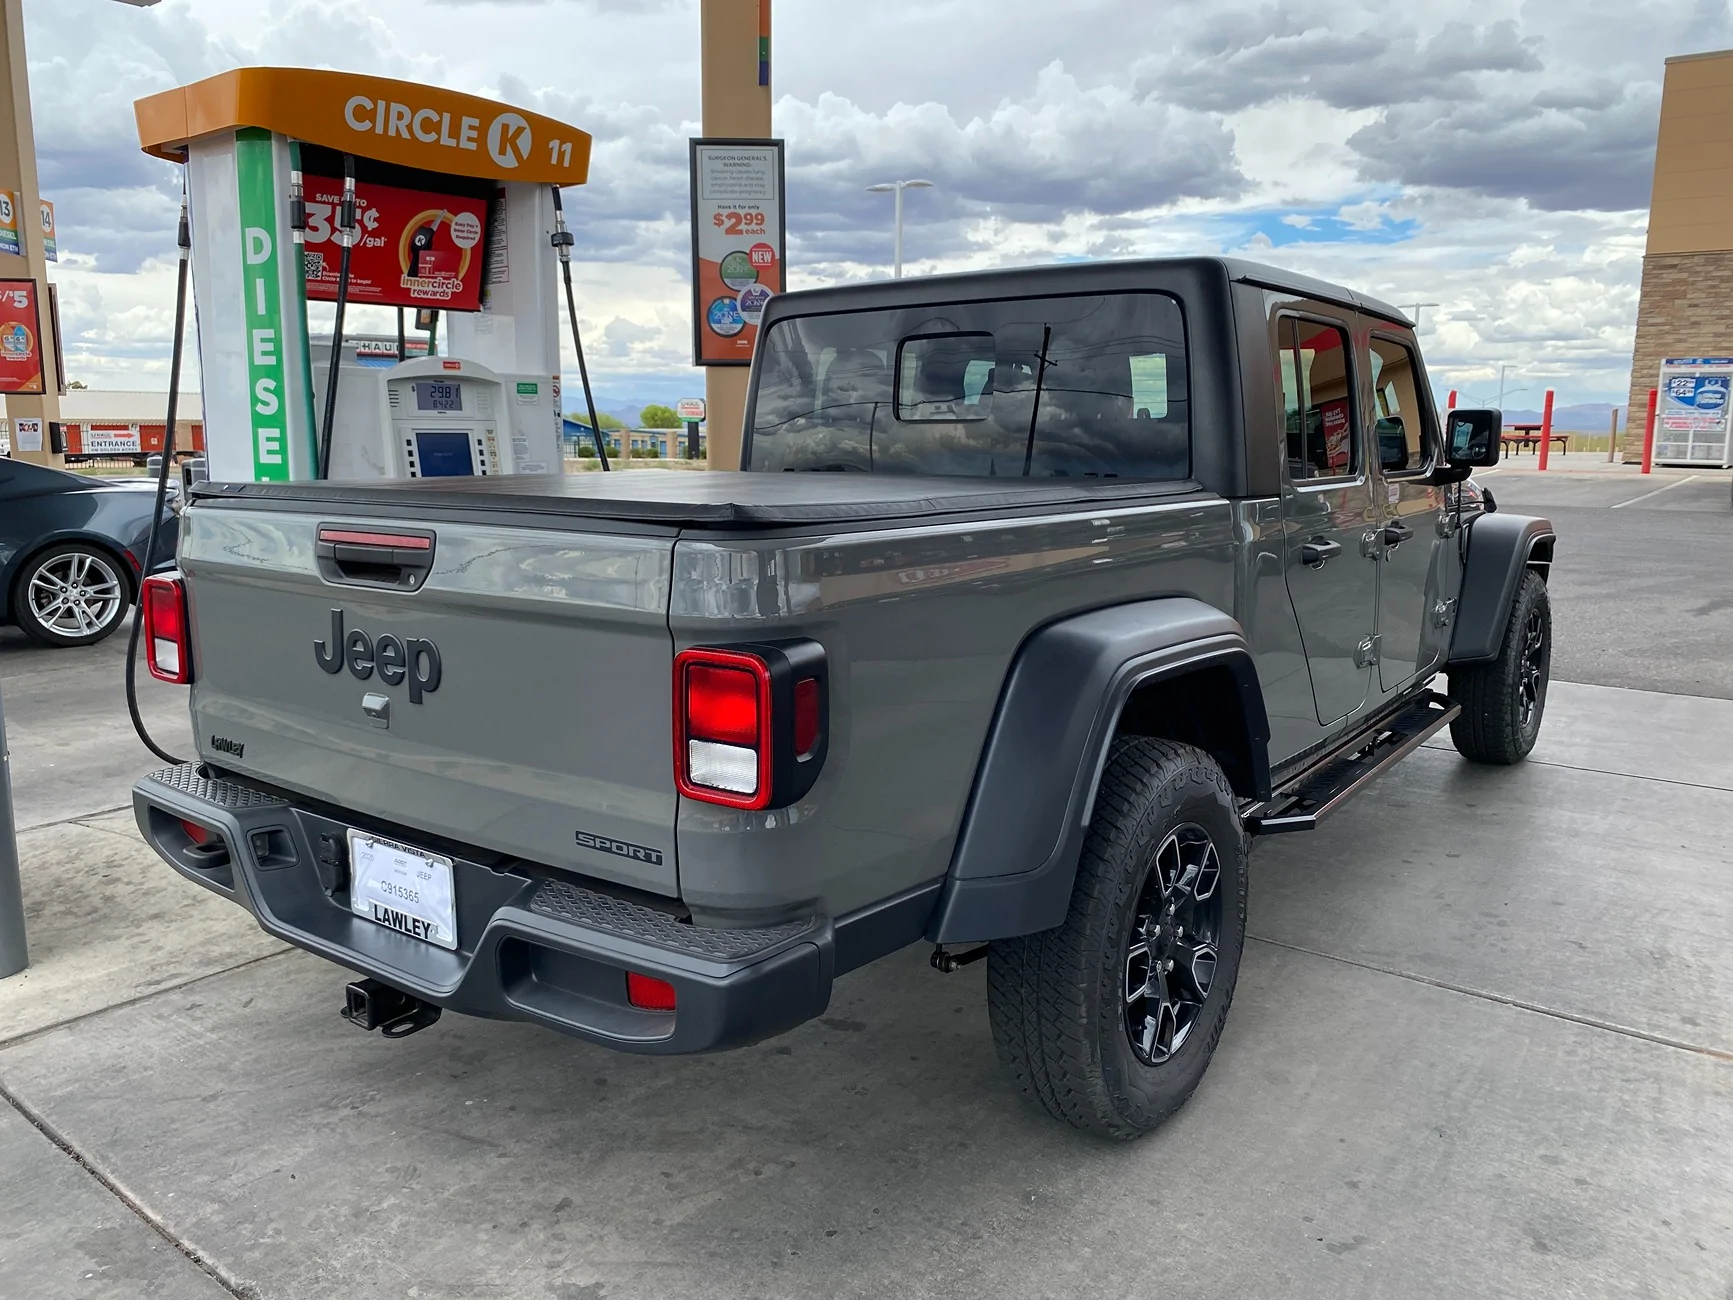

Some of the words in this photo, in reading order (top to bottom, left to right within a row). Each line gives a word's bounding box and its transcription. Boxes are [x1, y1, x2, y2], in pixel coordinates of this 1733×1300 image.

[344, 95, 480, 151] CIRCLE
[490, 116, 531, 167] K
[548, 138, 573, 168] 11
[315, 193, 340, 203] SAVE
[40, 210, 52, 228] 14
[752, 251, 772, 263] NEW
[412, 289, 450, 298] rewards
[91, 440, 138, 448] ENTRANCE
[313, 608, 442, 705] Jeep
[211, 734, 245, 759] LAWLEY
[402, 846, 426, 859] VISTA
[576, 831, 664, 866] SPORT
[416, 871, 432, 880] JEEP
[381, 880, 420, 904] C915365
[373, 903, 432, 940] LAWLEY
